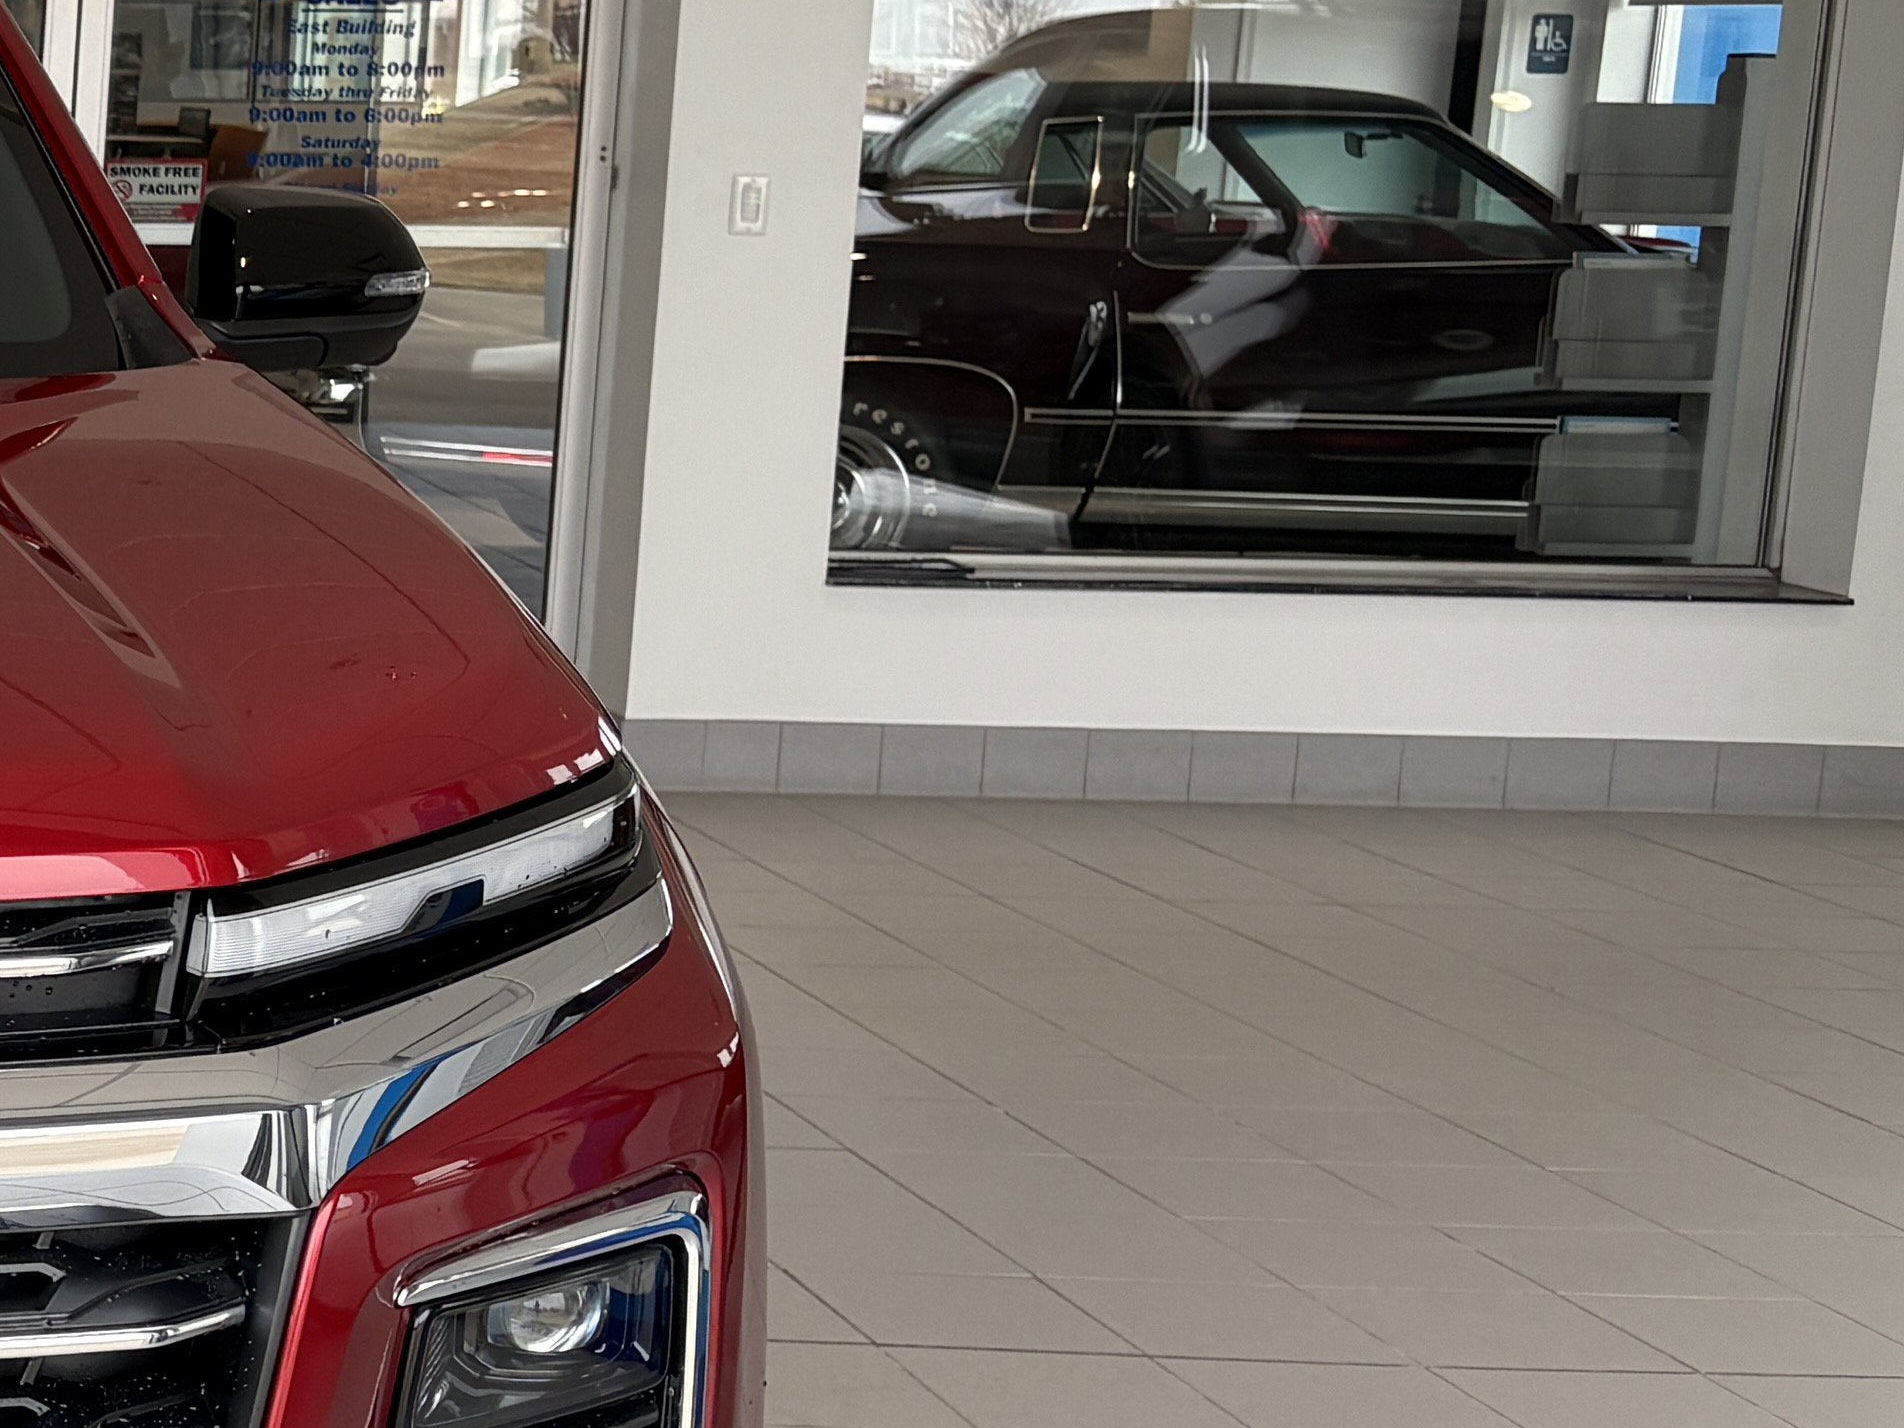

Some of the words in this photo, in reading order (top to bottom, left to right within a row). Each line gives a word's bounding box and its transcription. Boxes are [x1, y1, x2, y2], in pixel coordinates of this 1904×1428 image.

[290, 20, 330, 35] East
[336, 19, 415, 38] Building
[313, 43, 378, 57] Monday
[338, 63, 358, 77] to
[262, 86, 334, 100] Tuesday
[339, 86, 373, 98] thru
[381, 86, 432, 100] Friday
[250, 107, 327, 123] 9:00am
[335, 108, 356, 122] to
[364, 107, 443, 125] 6:00pm
[301, 135, 381, 149] Saturday
[332, 153, 352, 167] to
[110, 166, 161, 178] SMOKE
[165, 166, 200, 178] FREE
[139, 184, 199, 195] FACILITY
